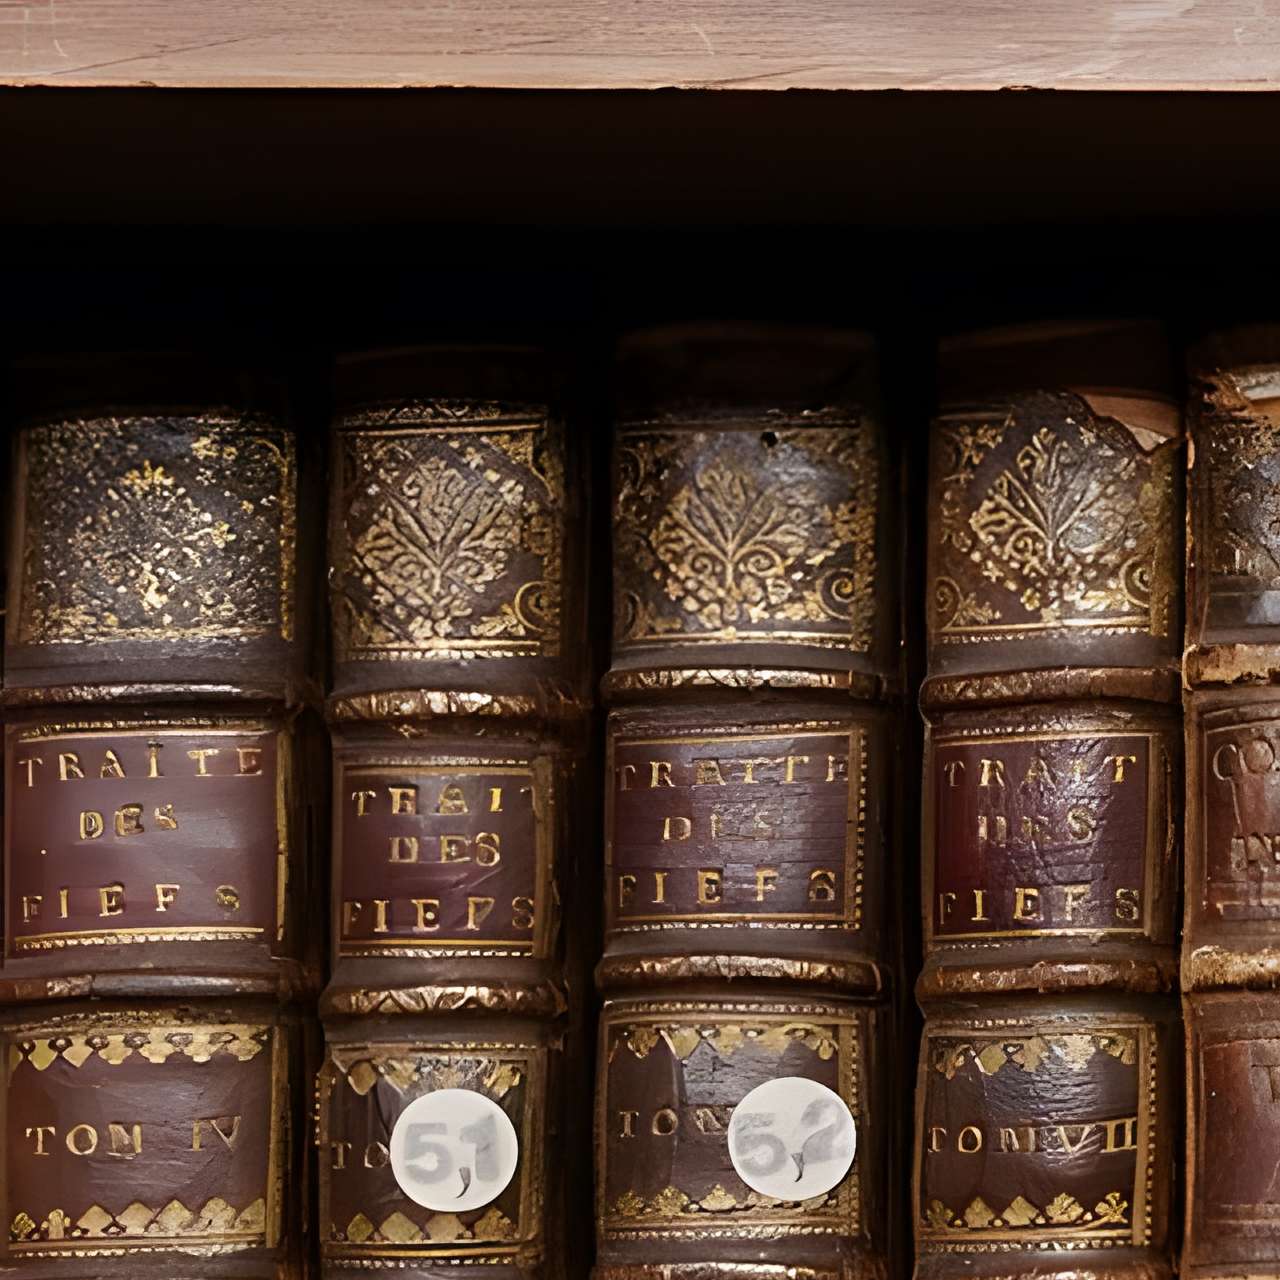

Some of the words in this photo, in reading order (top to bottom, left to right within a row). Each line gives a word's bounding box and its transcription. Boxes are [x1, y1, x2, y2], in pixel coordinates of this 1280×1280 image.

[79, 803, 178, 840] DES
[388, 832, 501, 867] DES
[939, 885, 1140, 924] FIEFS
